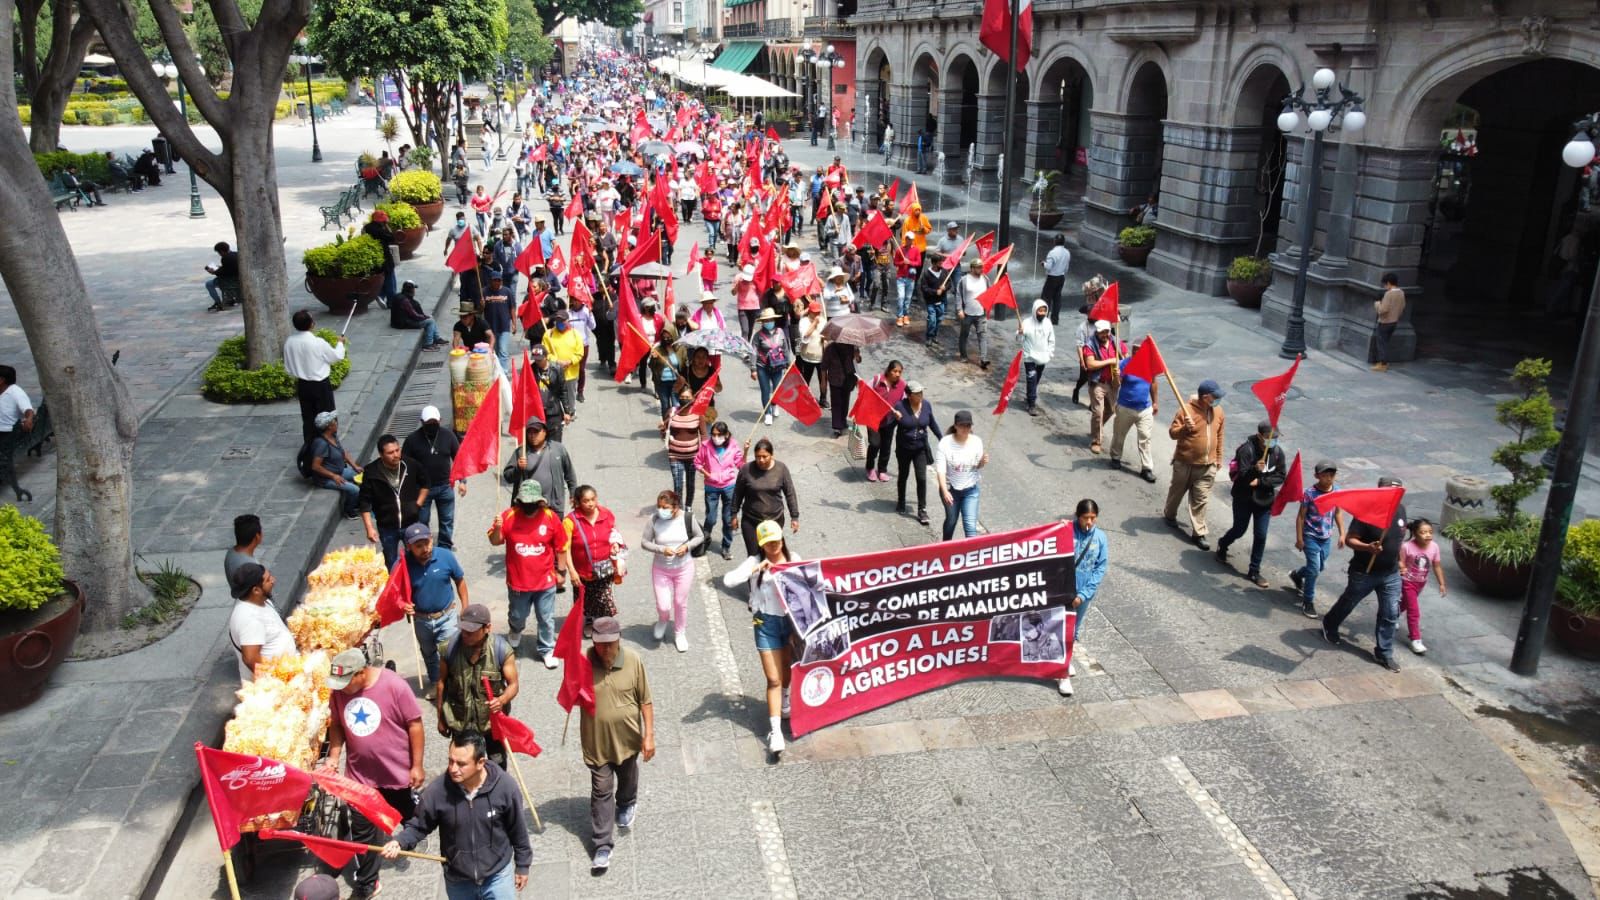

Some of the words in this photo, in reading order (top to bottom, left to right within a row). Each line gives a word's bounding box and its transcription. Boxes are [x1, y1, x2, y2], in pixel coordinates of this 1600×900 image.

[820, 559, 944, 593] ANTORCHA
[949, 537, 1057, 570] DEFIENDE
[828, 612, 911, 640] MERCADO
[918, 608, 939, 620] DE
[945, 591, 1047, 619] AMALUCAN
[836, 600, 870, 615] LOS
[877, 576, 1010, 610] COMERCIANTES
[1015, 571, 1046, 588] DEL
[840, 638, 899, 675] ¡ALTO
[906, 634, 924, 651] A
[932, 625, 974, 646] LAS
[840, 646, 988, 699] AGRESIONES!
